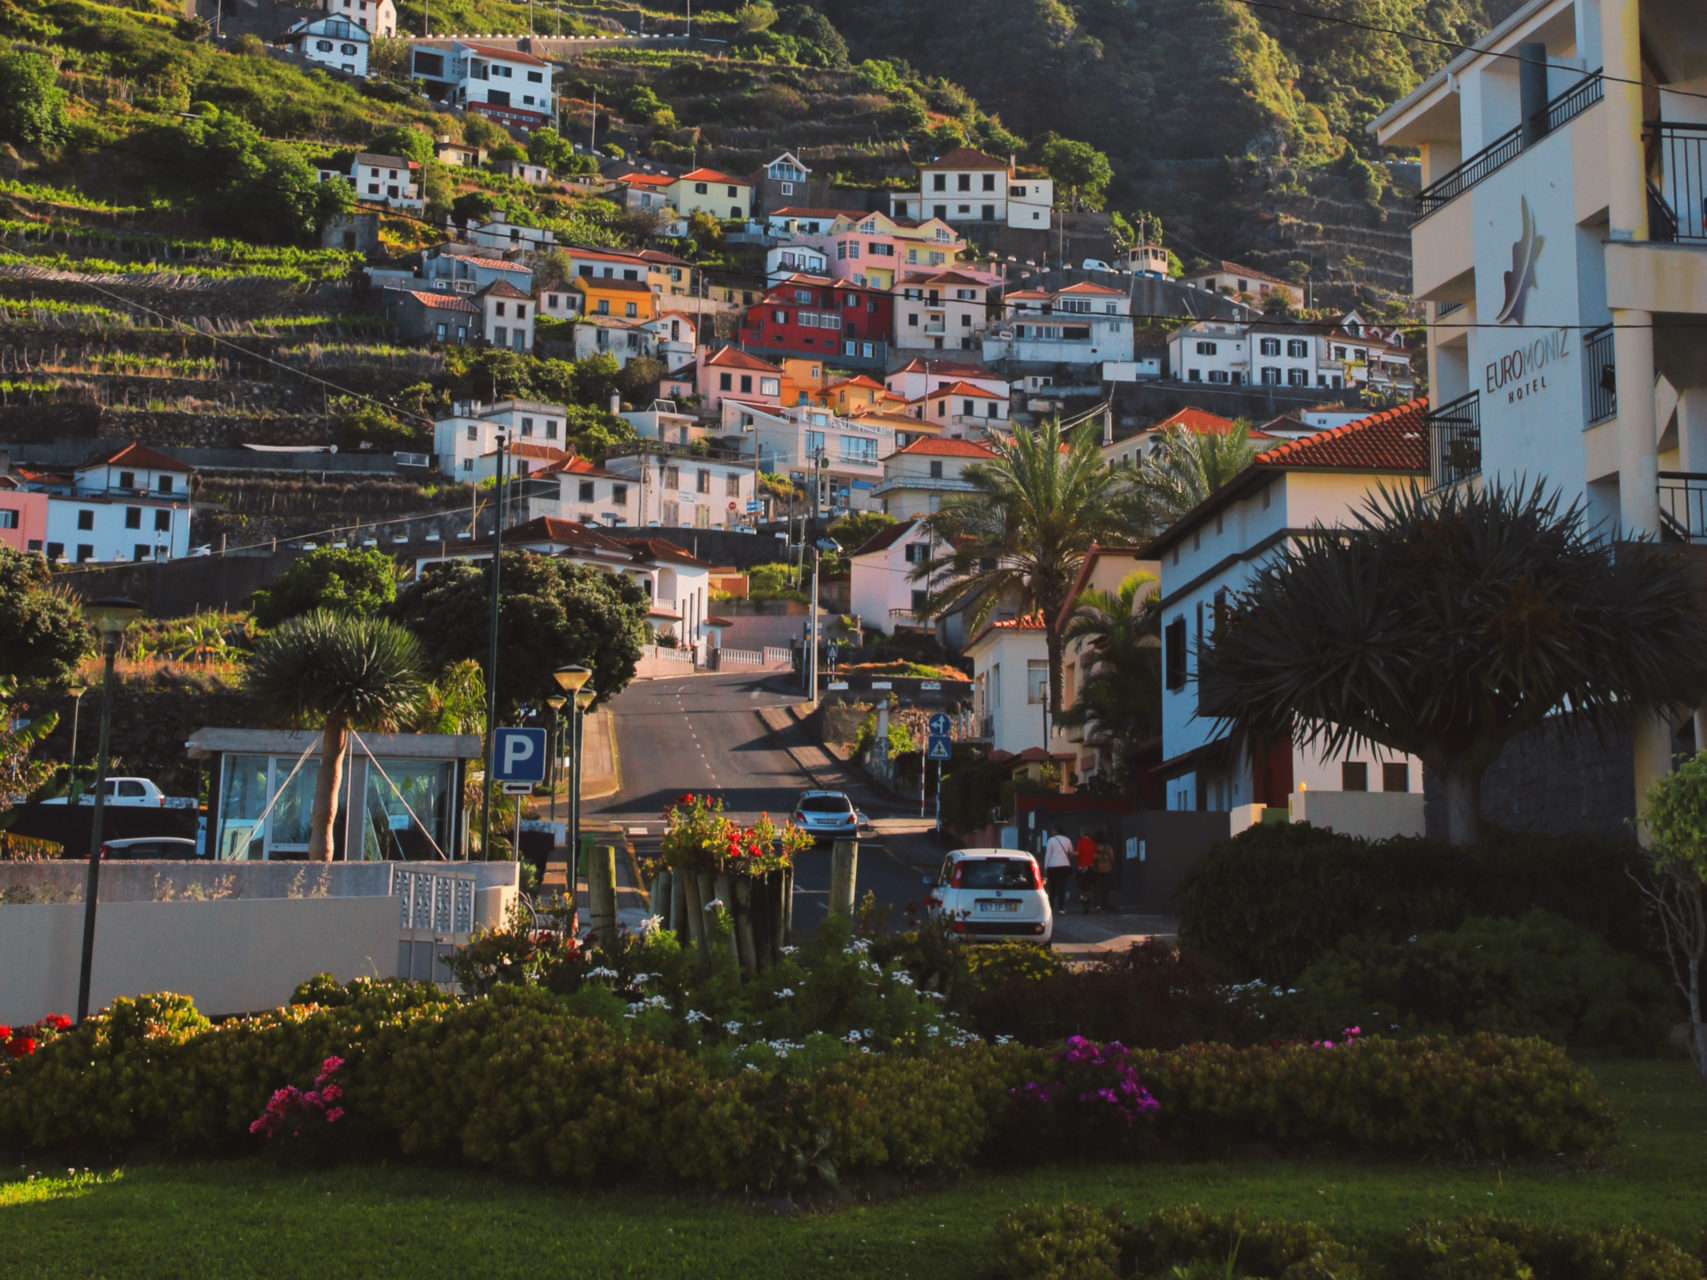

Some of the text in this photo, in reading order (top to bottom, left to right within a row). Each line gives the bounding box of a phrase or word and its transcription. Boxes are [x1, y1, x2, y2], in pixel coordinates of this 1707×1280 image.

[1486, 326, 1569, 393] EUROMONIZ
[1508, 376, 1546, 403] HOTEL
[503, 734, 534, 775] P
